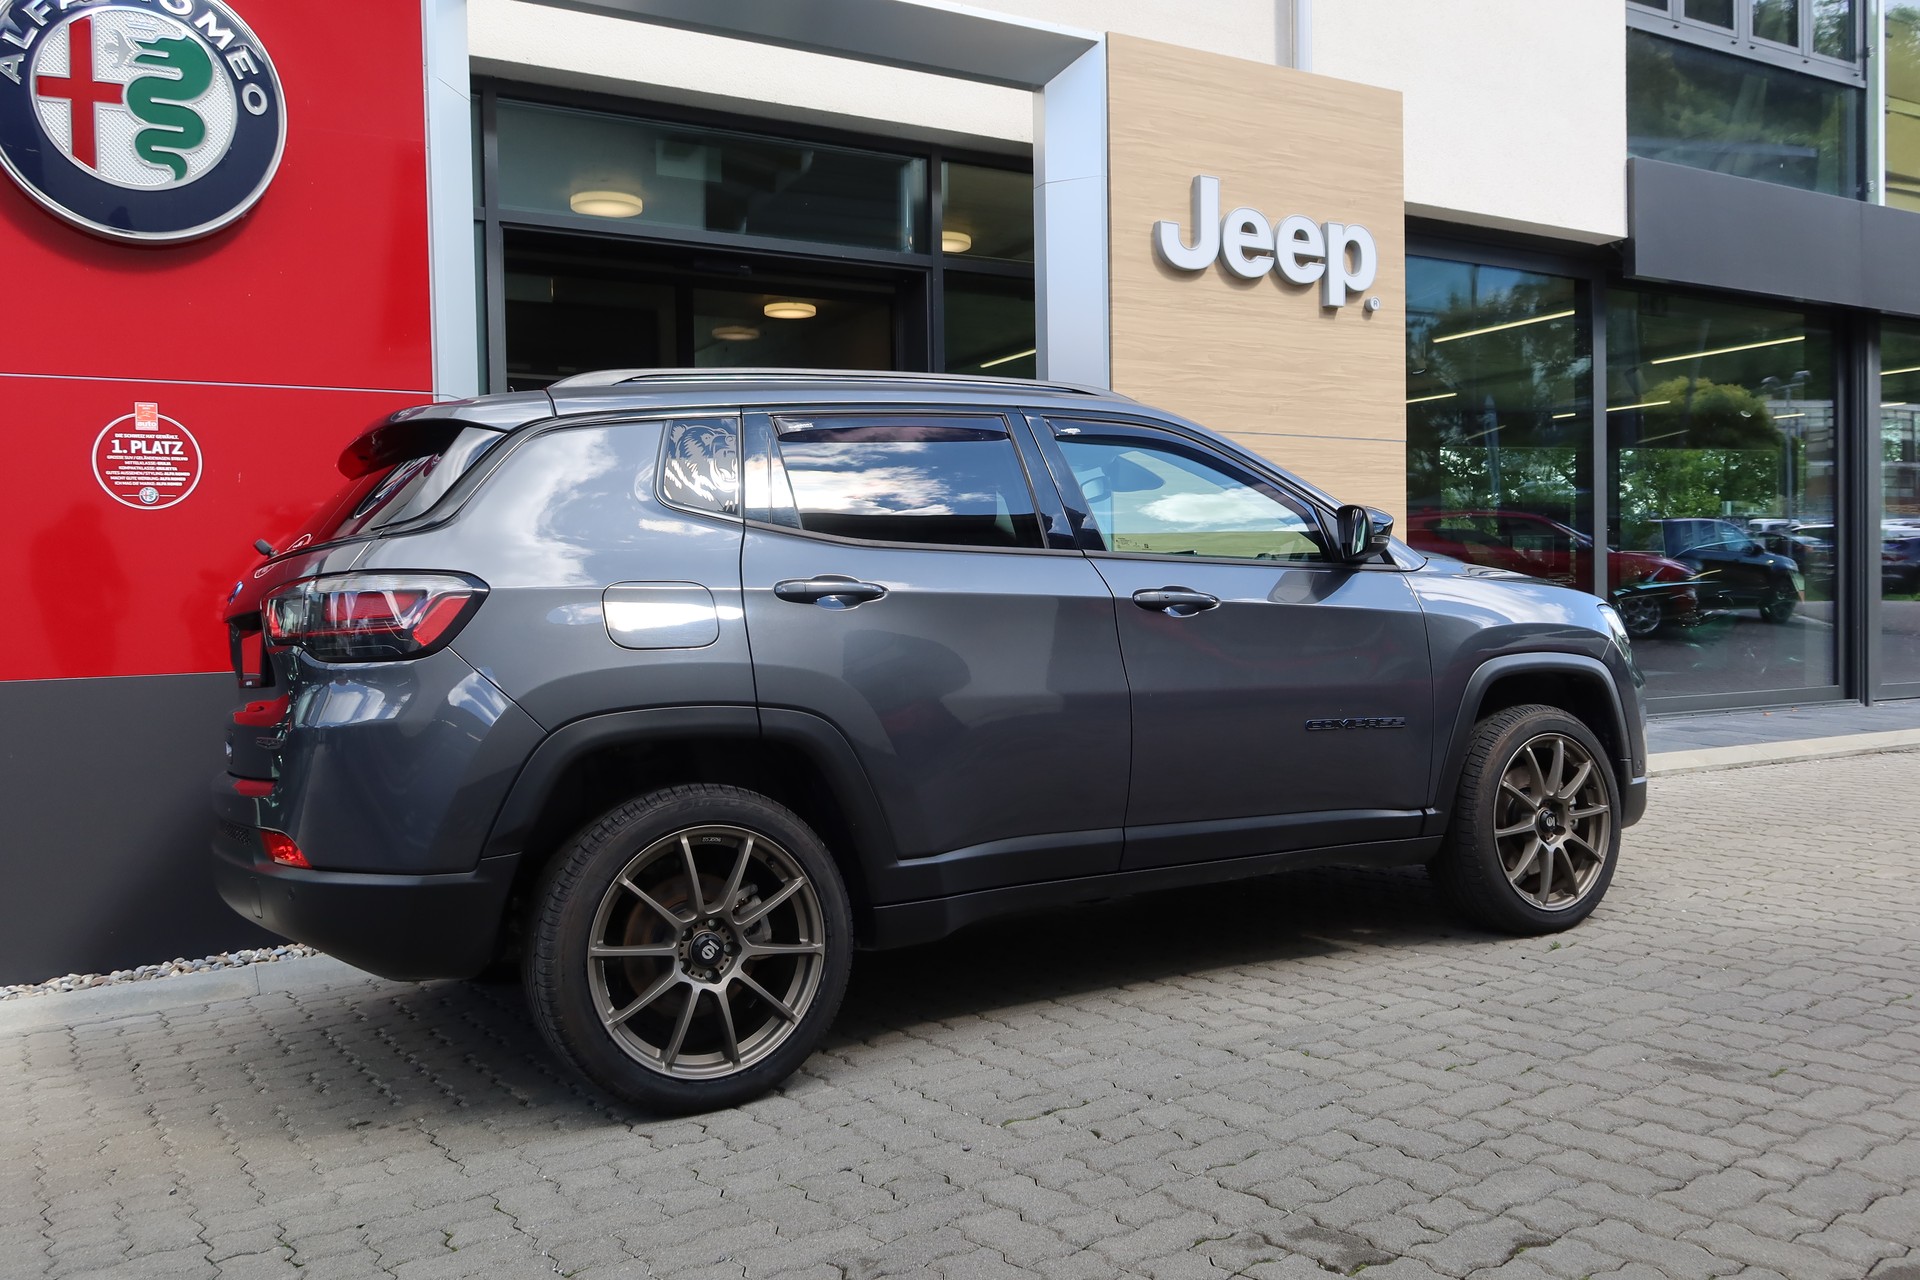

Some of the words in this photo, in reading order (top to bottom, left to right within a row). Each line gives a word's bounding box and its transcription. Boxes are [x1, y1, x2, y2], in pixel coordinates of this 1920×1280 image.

[0, 0, 93, 85] ALF
[140, 0, 268, 116] OMEO
[1152, 174, 1378, 308] Jeep
[111, 440, 128, 454] 1.
[130, 440, 184, 455] PLATZ
